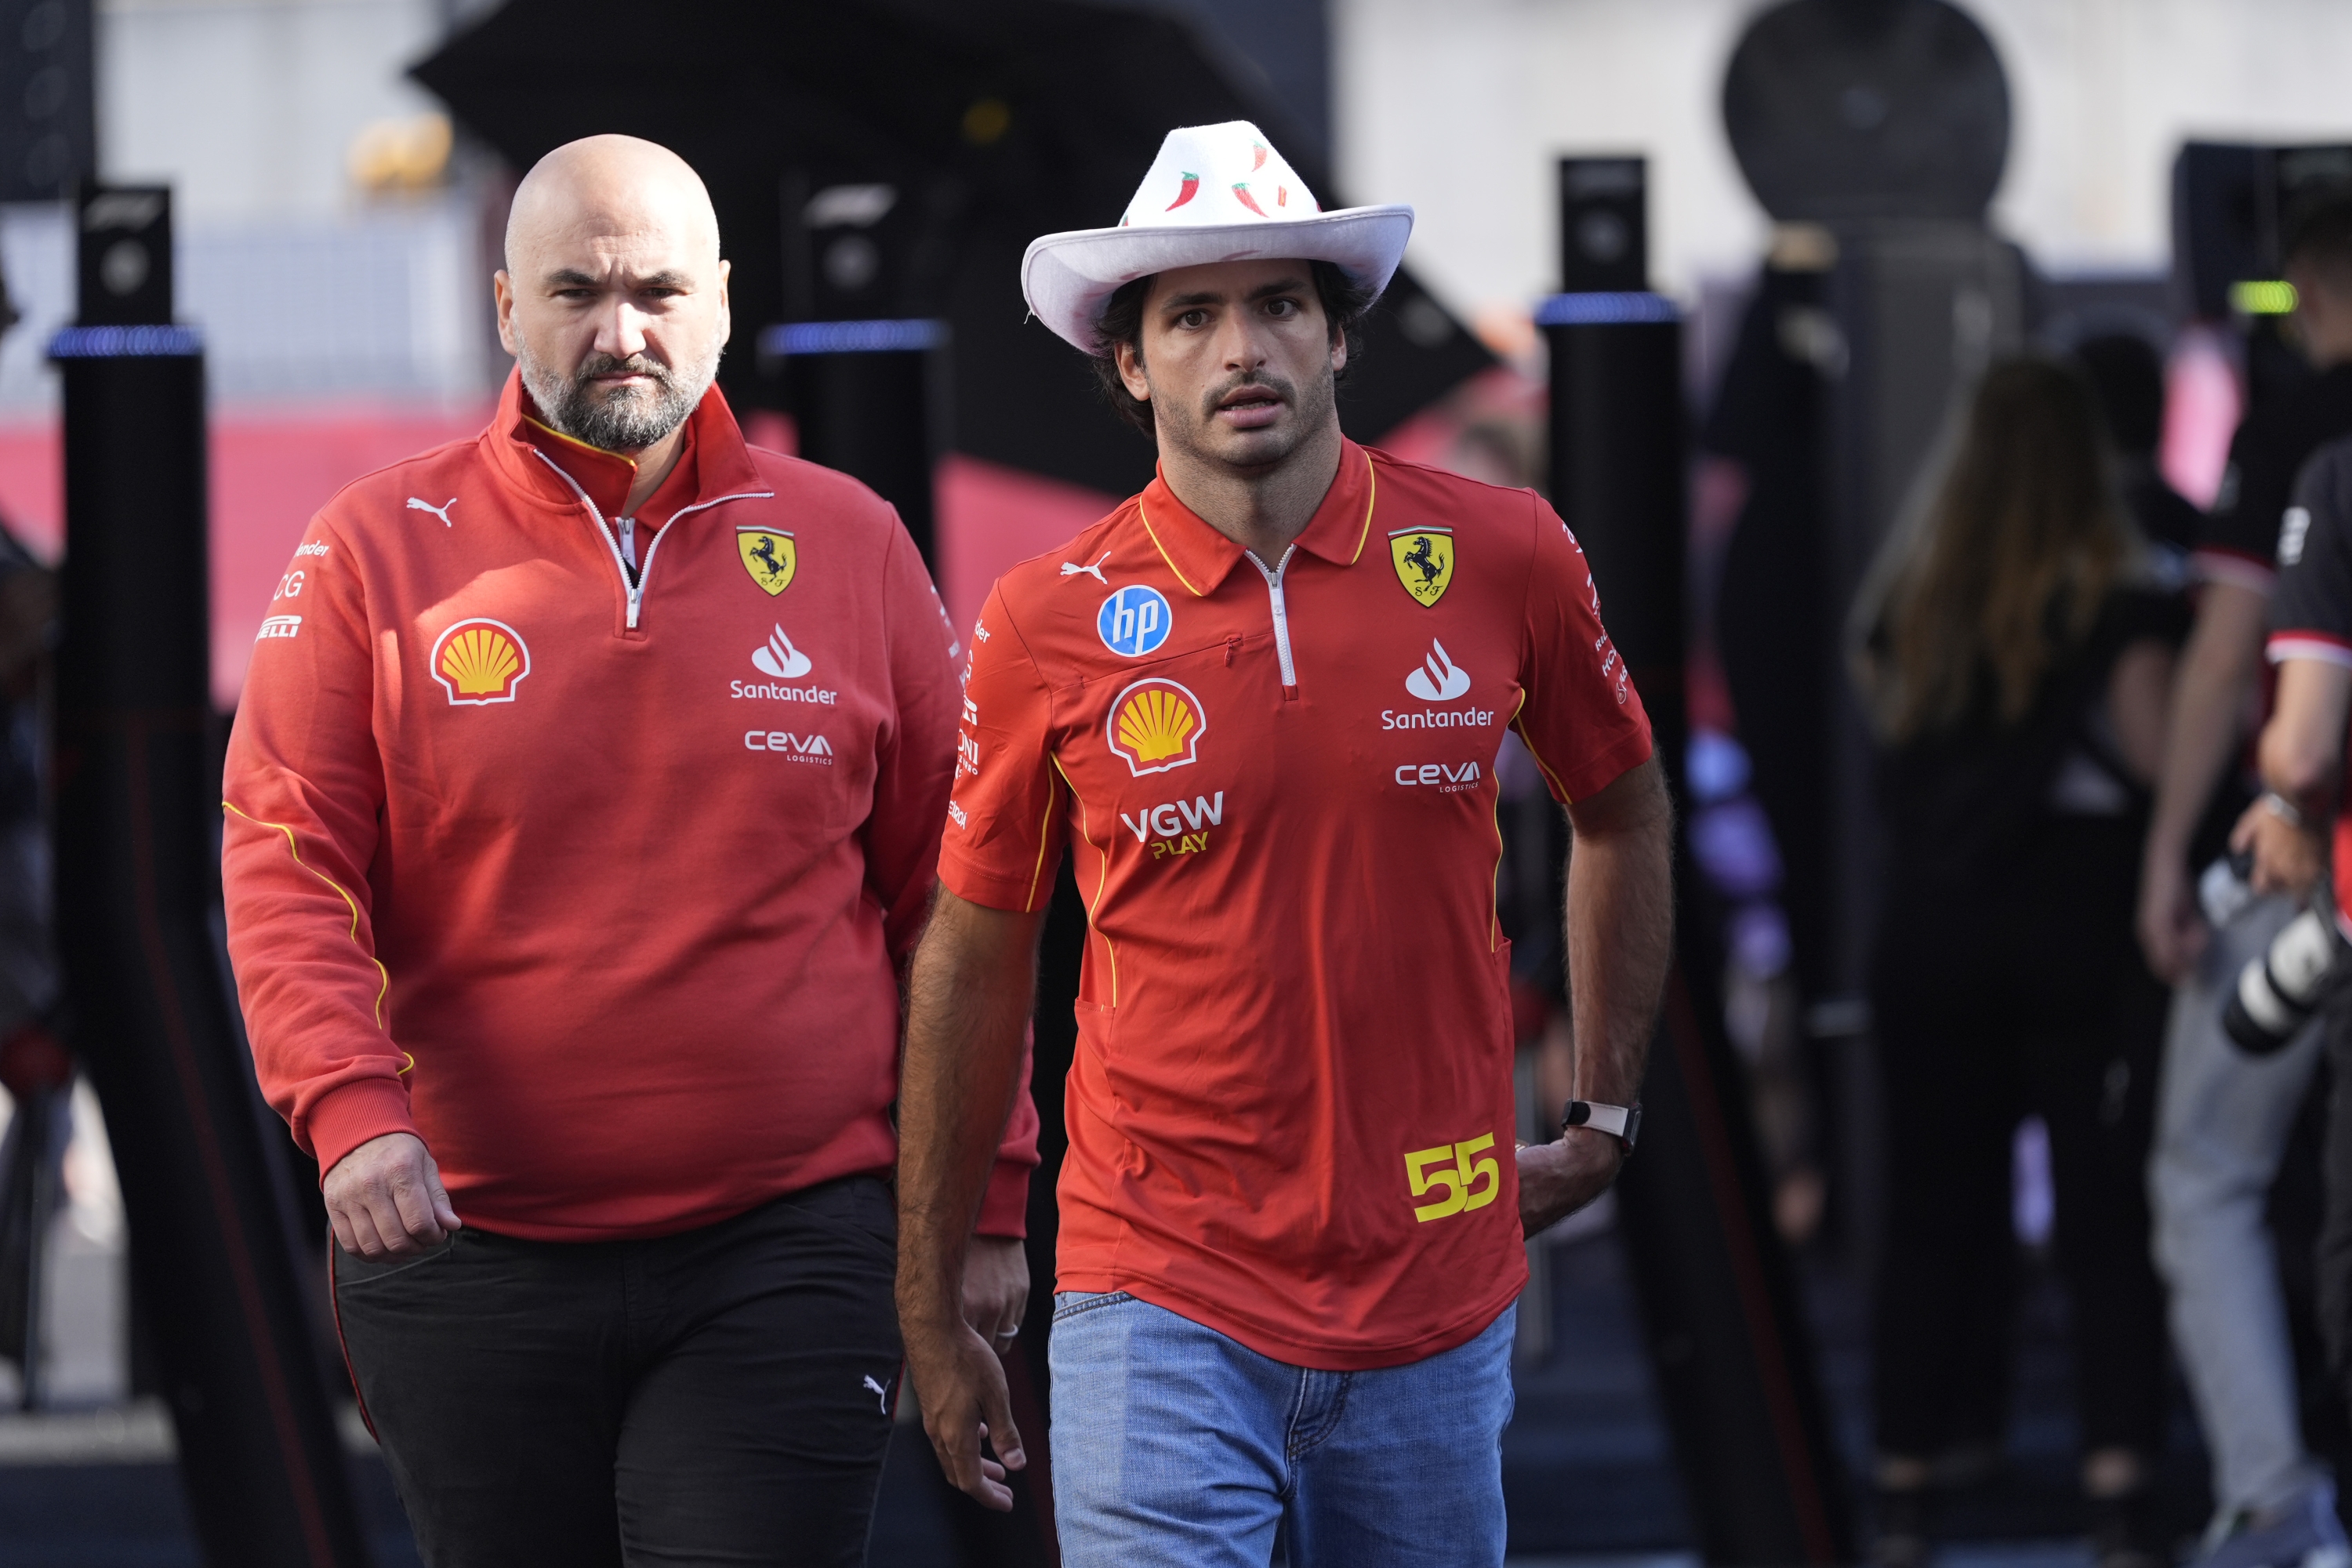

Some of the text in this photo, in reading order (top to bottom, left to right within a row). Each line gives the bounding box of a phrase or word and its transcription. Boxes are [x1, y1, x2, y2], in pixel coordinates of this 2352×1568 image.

[1112, 592, 1159, 654] hp
[730, 680, 837, 705] Santander
[1381, 707, 1494, 730] Santander
[786, 755, 833, 766] LOGISTICS
[1439, 781, 1479, 793] LOGISTICS
[1120, 790, 1224, 843] VGW
[1149, 831, 1209, 860] PLAY
[1403, 1131, 1500, 1223] 55
